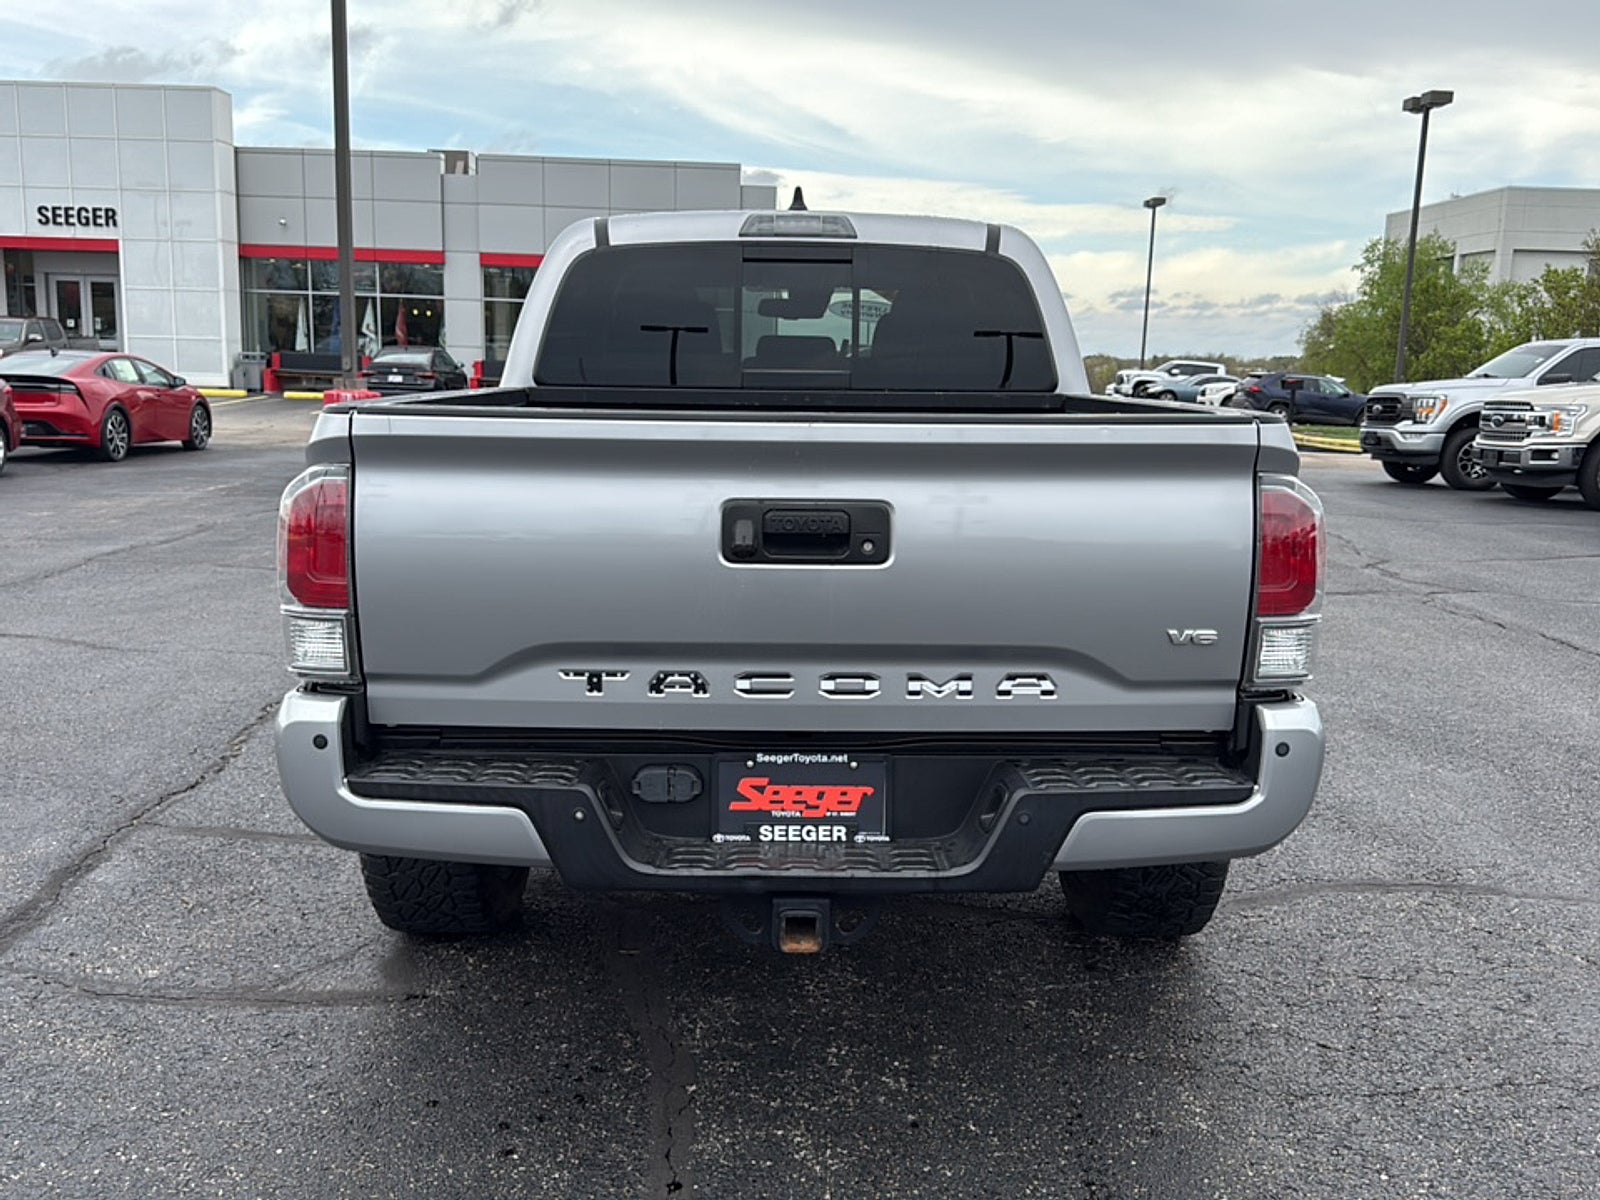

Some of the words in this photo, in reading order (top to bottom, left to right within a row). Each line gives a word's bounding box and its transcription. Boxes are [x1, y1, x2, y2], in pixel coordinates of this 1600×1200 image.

[37, 205, 118, 228] SEEGER
[771, 516, 844, 533] TOYOTA
[1166, 629, 1218, 646] V6
[558, 669, 1058, 699] TACOMA
[756, 753, 848, 764] SeegerToyota.net
[729, 777, 875, 818] Seeger
[759, 825, 847, 841] SEEGER
